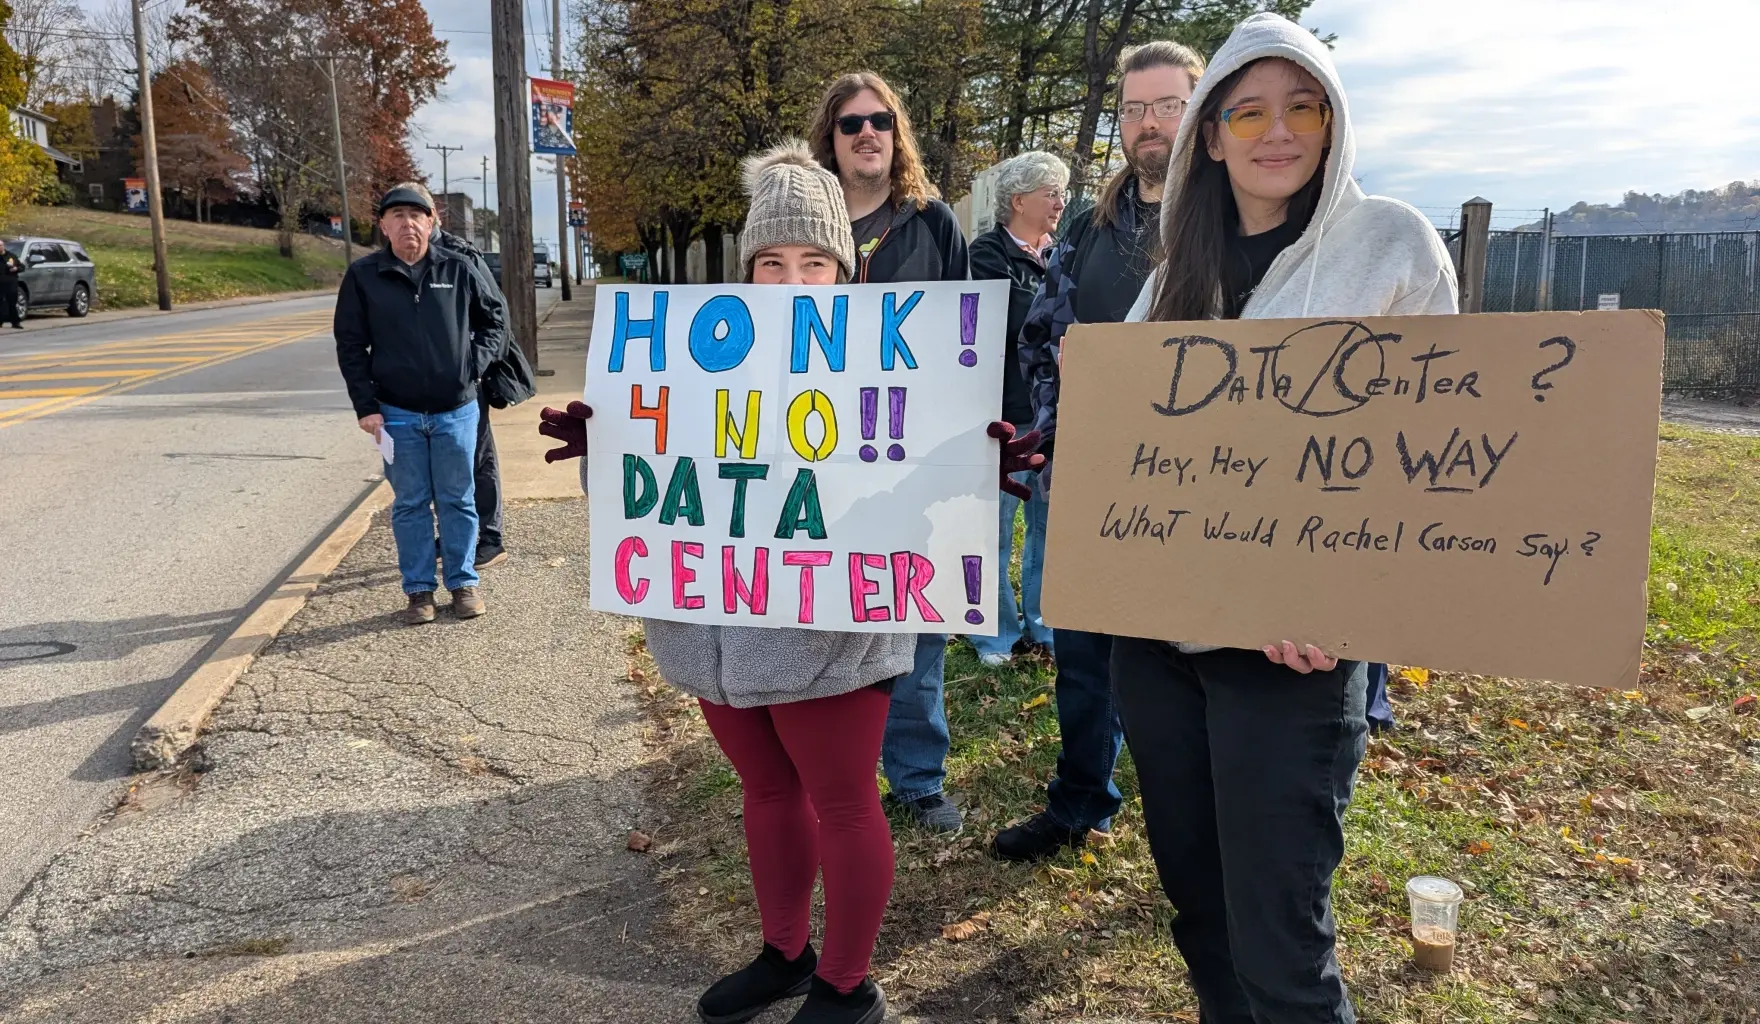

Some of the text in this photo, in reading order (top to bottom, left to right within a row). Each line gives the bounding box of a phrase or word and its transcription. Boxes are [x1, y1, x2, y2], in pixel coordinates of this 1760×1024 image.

[629, 384, 670, 455] 4
[1209, 445, 1269, 488] Hey
[1295, 434, 1375, 487] NO
[1396, 426, 1519, 489] WAY
[622, 453, 829, 540] DATA
[1203, 511, 1279, 548] Would
[1296, 515, 1404, 554] Rachel
[1418, 521, 1497, 554] Carson
